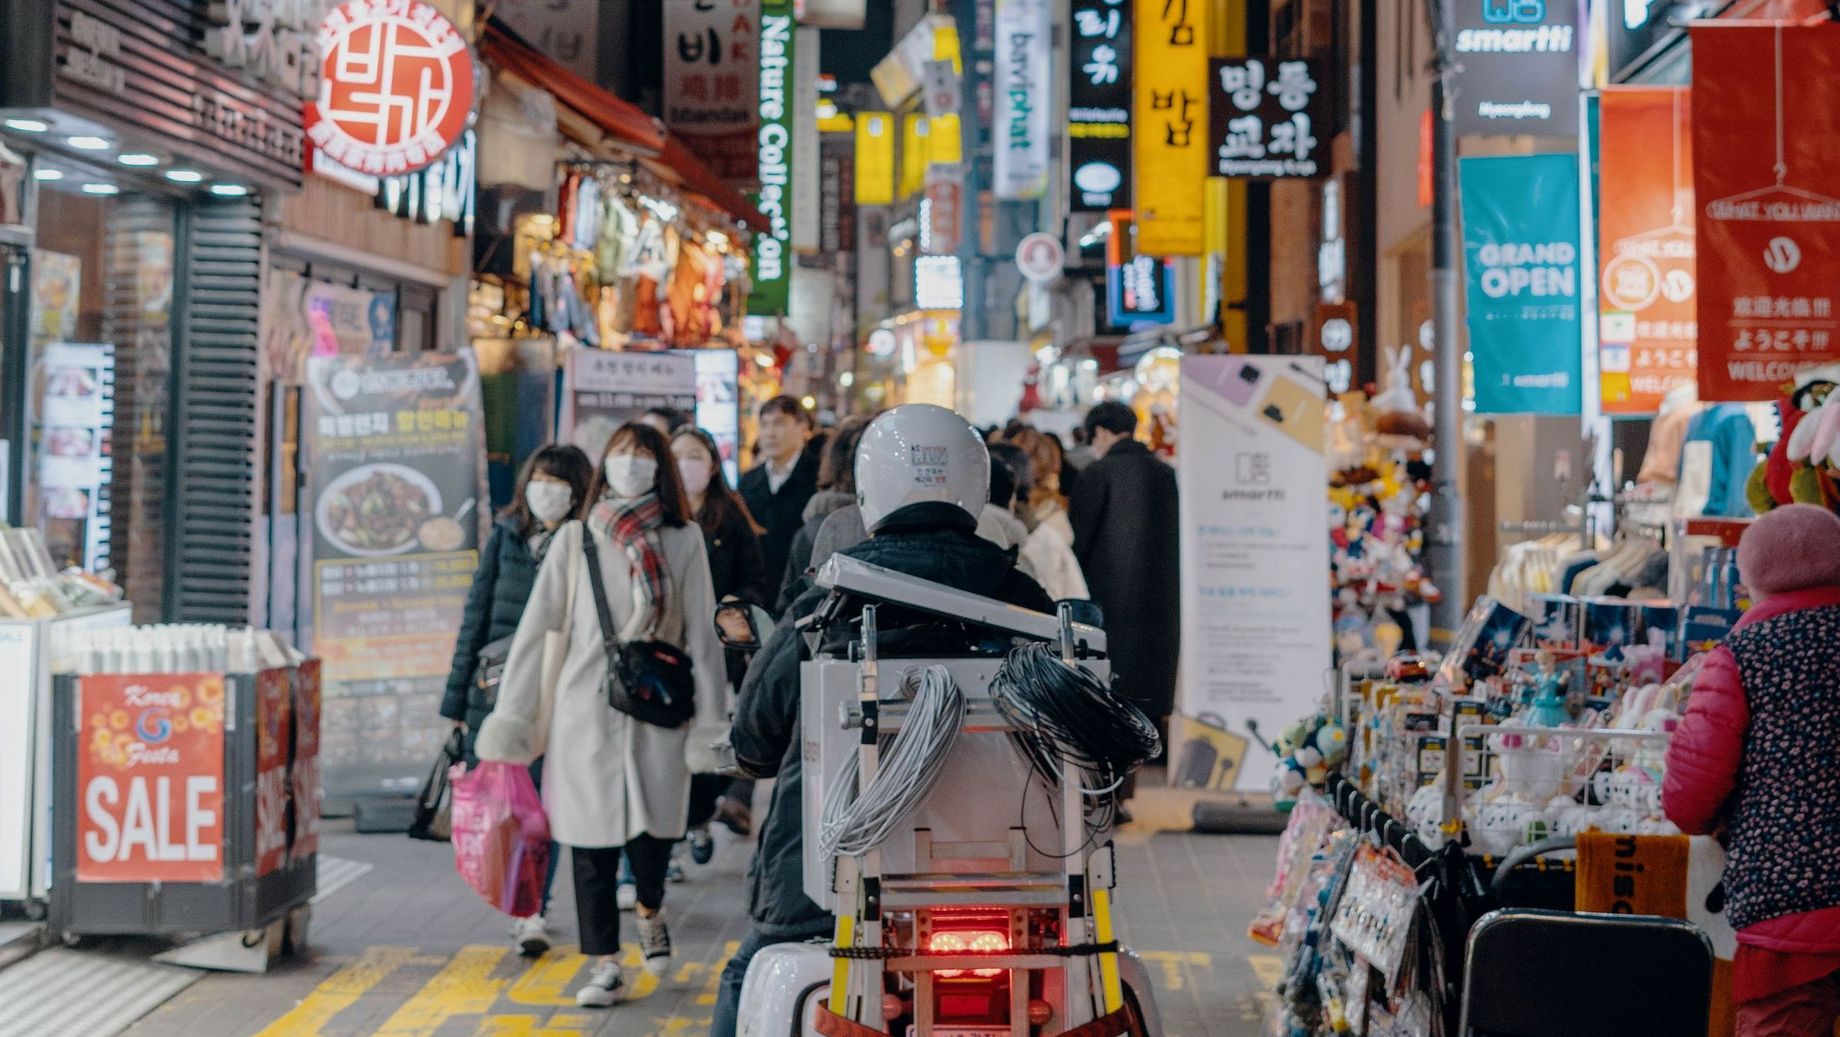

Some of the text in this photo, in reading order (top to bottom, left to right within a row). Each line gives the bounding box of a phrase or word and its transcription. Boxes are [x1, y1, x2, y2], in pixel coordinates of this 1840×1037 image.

[760, 15, 791, 120] Nature
[1219, 59, 1318, 111] 명동
[1218, 112, 1318, 160] 교자
[1479, 242, 1575, 267] GRAND
[1481, 266, 1575, 298] OPEN
[124, 685, 182, 706] Korea
[84, 775, 217, 863] SALE
